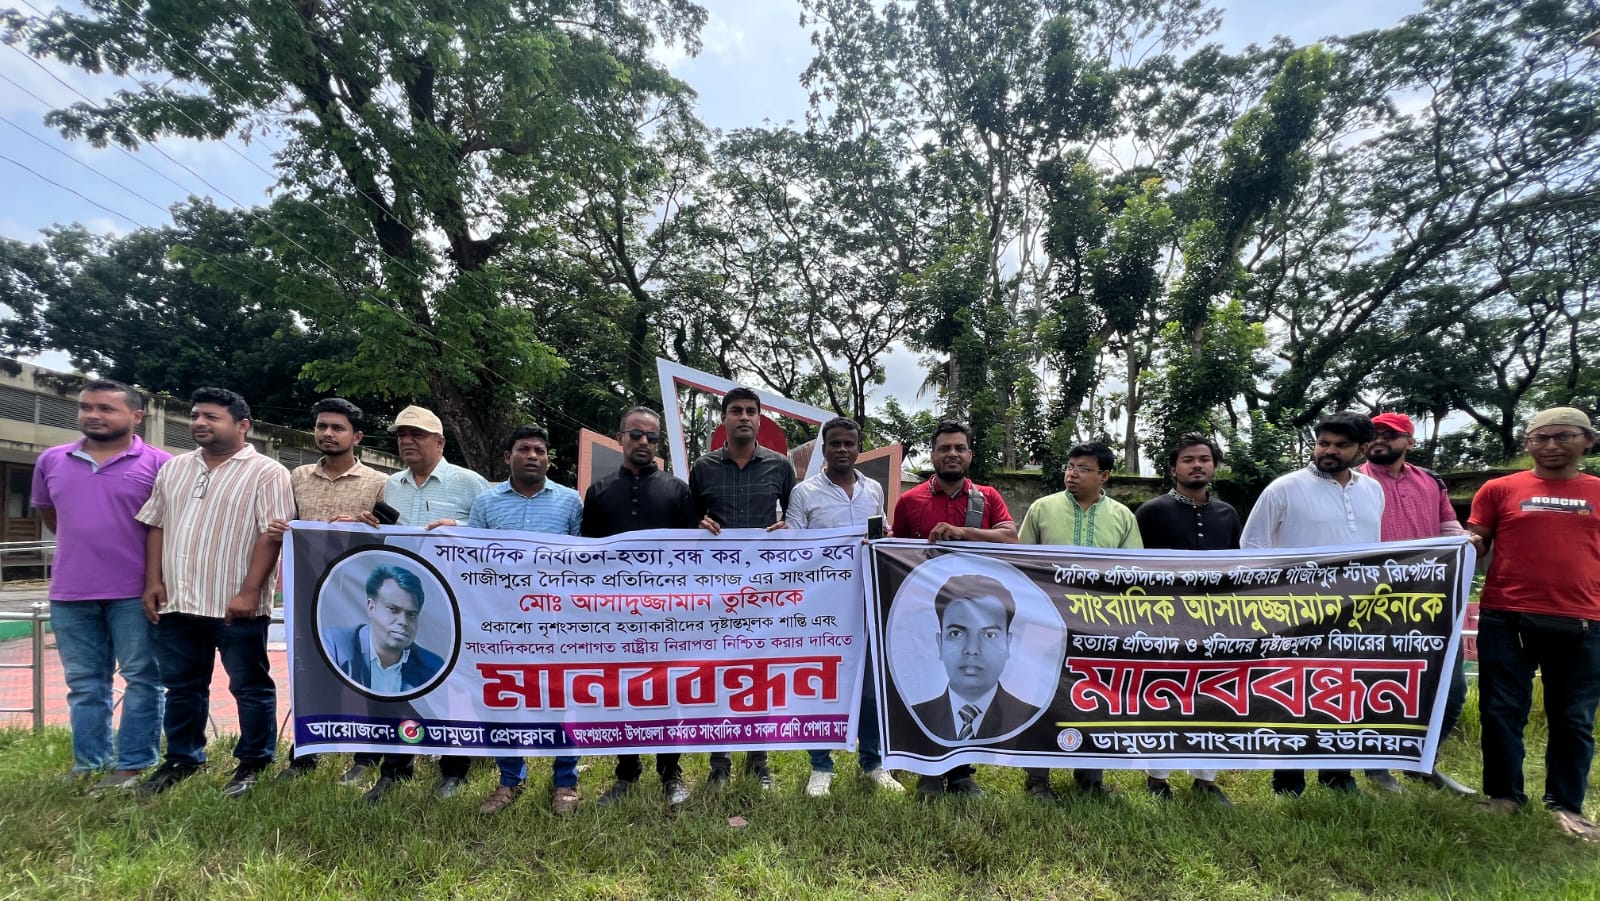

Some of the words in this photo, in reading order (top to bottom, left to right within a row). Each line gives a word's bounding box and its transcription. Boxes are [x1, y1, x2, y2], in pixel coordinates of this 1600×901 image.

[434, 543, 526, 565] সাংবাদিক
[758, 548, 813, 564] করতে
[821, 544, 856, 561] হবে
[460, 568, 533, 590] গাজীপুরে
[538, 570, 597, 587] দৈনিক
[602, 570, 688, 588] প্রতিদিনের
[694, 573, 743, 586] কাগজ
[749, 572, 774, 584] এর
[780, 566, 853, 584] সাংবাদিক
[1053, 563, 1100, 584] দৈনিক
[1104, 563, 1175, 586] প্রতিদিনের
[1179, 567, 1223, 586] কাগজ
[1228, 565, 1283, 586] পত্রিকার
[1286, 561, 1340, 589] গাজীপুর
[1343, 562, 1380, 584] স্টাফ
[1384, 557, 1447, 583] রিপোর্টার
[519, 593, 562, 612] মোঃ
[570, 592, 712, 616] আসাদুজ্জামান
[720, 587, 804, 614] তুহিনকে
[1065, 585, 1175, 626] সাংবাদিক
[1179, 592, 1344, 634] আসাদুজ্জামান
[1347, 583, 1447, 632] তুহিনকে
[481, 621, 533, 635] প্রকাশ্যে
[538, 622, 611, 638] নৃশংসভাবে
[616, 617, 704, 634] হত্যাকারীদের
[709, 616, 774, 634] দৃষ্টান্তমূলক
[778, 613, 807, 628] শাস্তি
[811, 615, 838, 627] এবং
[464, 639, 555, 655] সাংবাদিকদের
[560, 641, 616, 654] পেশাগত
[620, 637, 658, 654] রাষ্ট্রীয়
[663, 637, 719, 652] নিরাপত্তা
[722, 635, 767, 650] নিশ্চিত
[770, 636, 804, 648] করার
[808, 632, 855, 647] দাবিতে
[1072, 633, 1120, 652] হত্যার
[1123, 630, 1180, 654] প্রতিবাদ
[1184, 639, 1198, 653] ও
[1202, 632, 1258, 658] খুনিদের
[1260, 633, 1324, 657] দৃষ্টান্তমূলক
[1328, 629, 1387, 652] বিচারের
[1390, 629, 1446, 652] দাবিতে
[476, 656, 844, 714] মানববন্ধন
[1066, 656, 1428, 724] মানববন্ধন
[426, 725, 485, 746] ডামুড্যা
[489, 727, 556, 746] প্রেসক্লাব
[624, 723, 664, 742] উপজেলা
[667, 720, 697, 740] কর্মরত
[699, 719, 742, 741] সাংবাদিক
[744, 724, 751, 736] ও
[754, 722, 777, 739] সকল
[780, 717, 801, 738] শ্রেণি
[803, 720, 831, 737] পেশার
[1089, 731, 1178, 754] ডামুড্যা
[1185, 728, 1309, 753] সাংবাদিক
[1315, 728, 1425, 754] ইউনিয়ন
